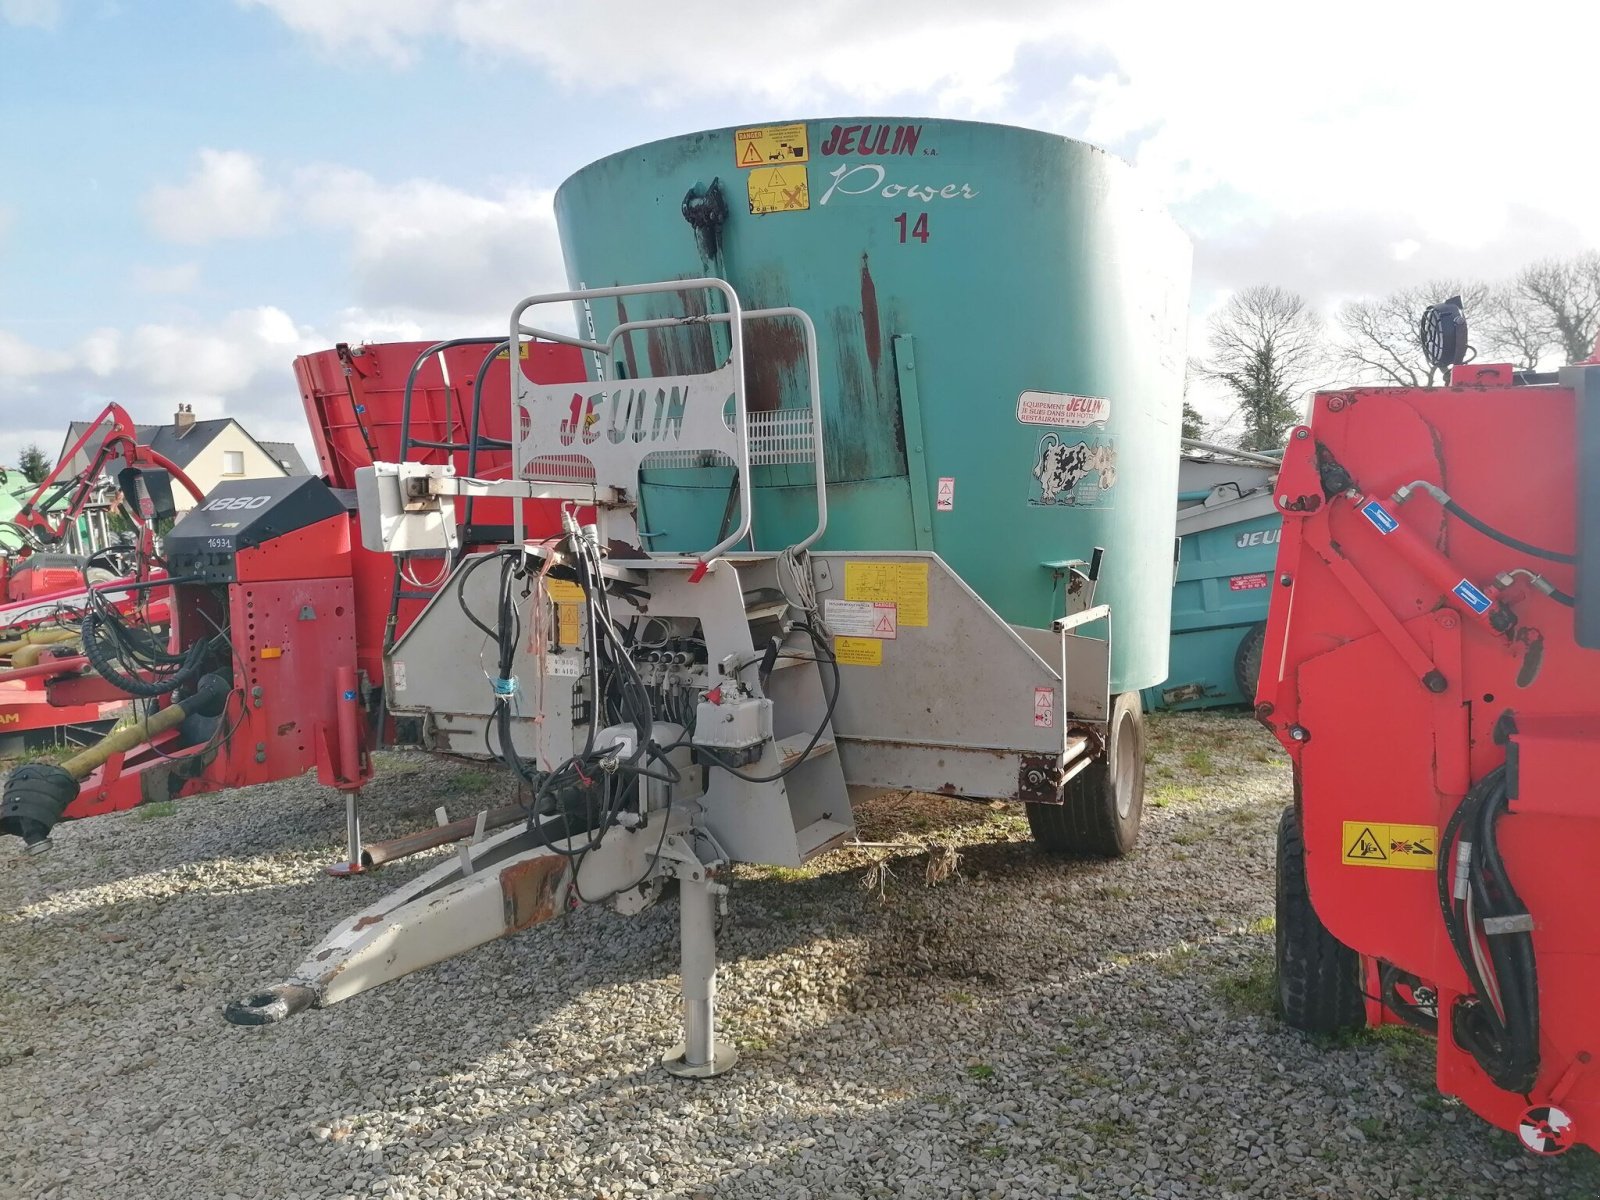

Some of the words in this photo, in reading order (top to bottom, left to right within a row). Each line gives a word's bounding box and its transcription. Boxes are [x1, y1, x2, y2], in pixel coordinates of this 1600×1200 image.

[739, 131, 762, 139] DANGER
[821, 124, 922, 156] JEULIN
[820, 163, 980, 205] Power
[894, 212, 930, 243] 14
[1066, 397, 1102, 413] JEULIN
[560, 385, 689, 446] JEULIN
[1021, 414, 1065, 423] RESTAURANT
[201, 496, 272, 511] 1880
[207, 538, 232, 548] 16931
